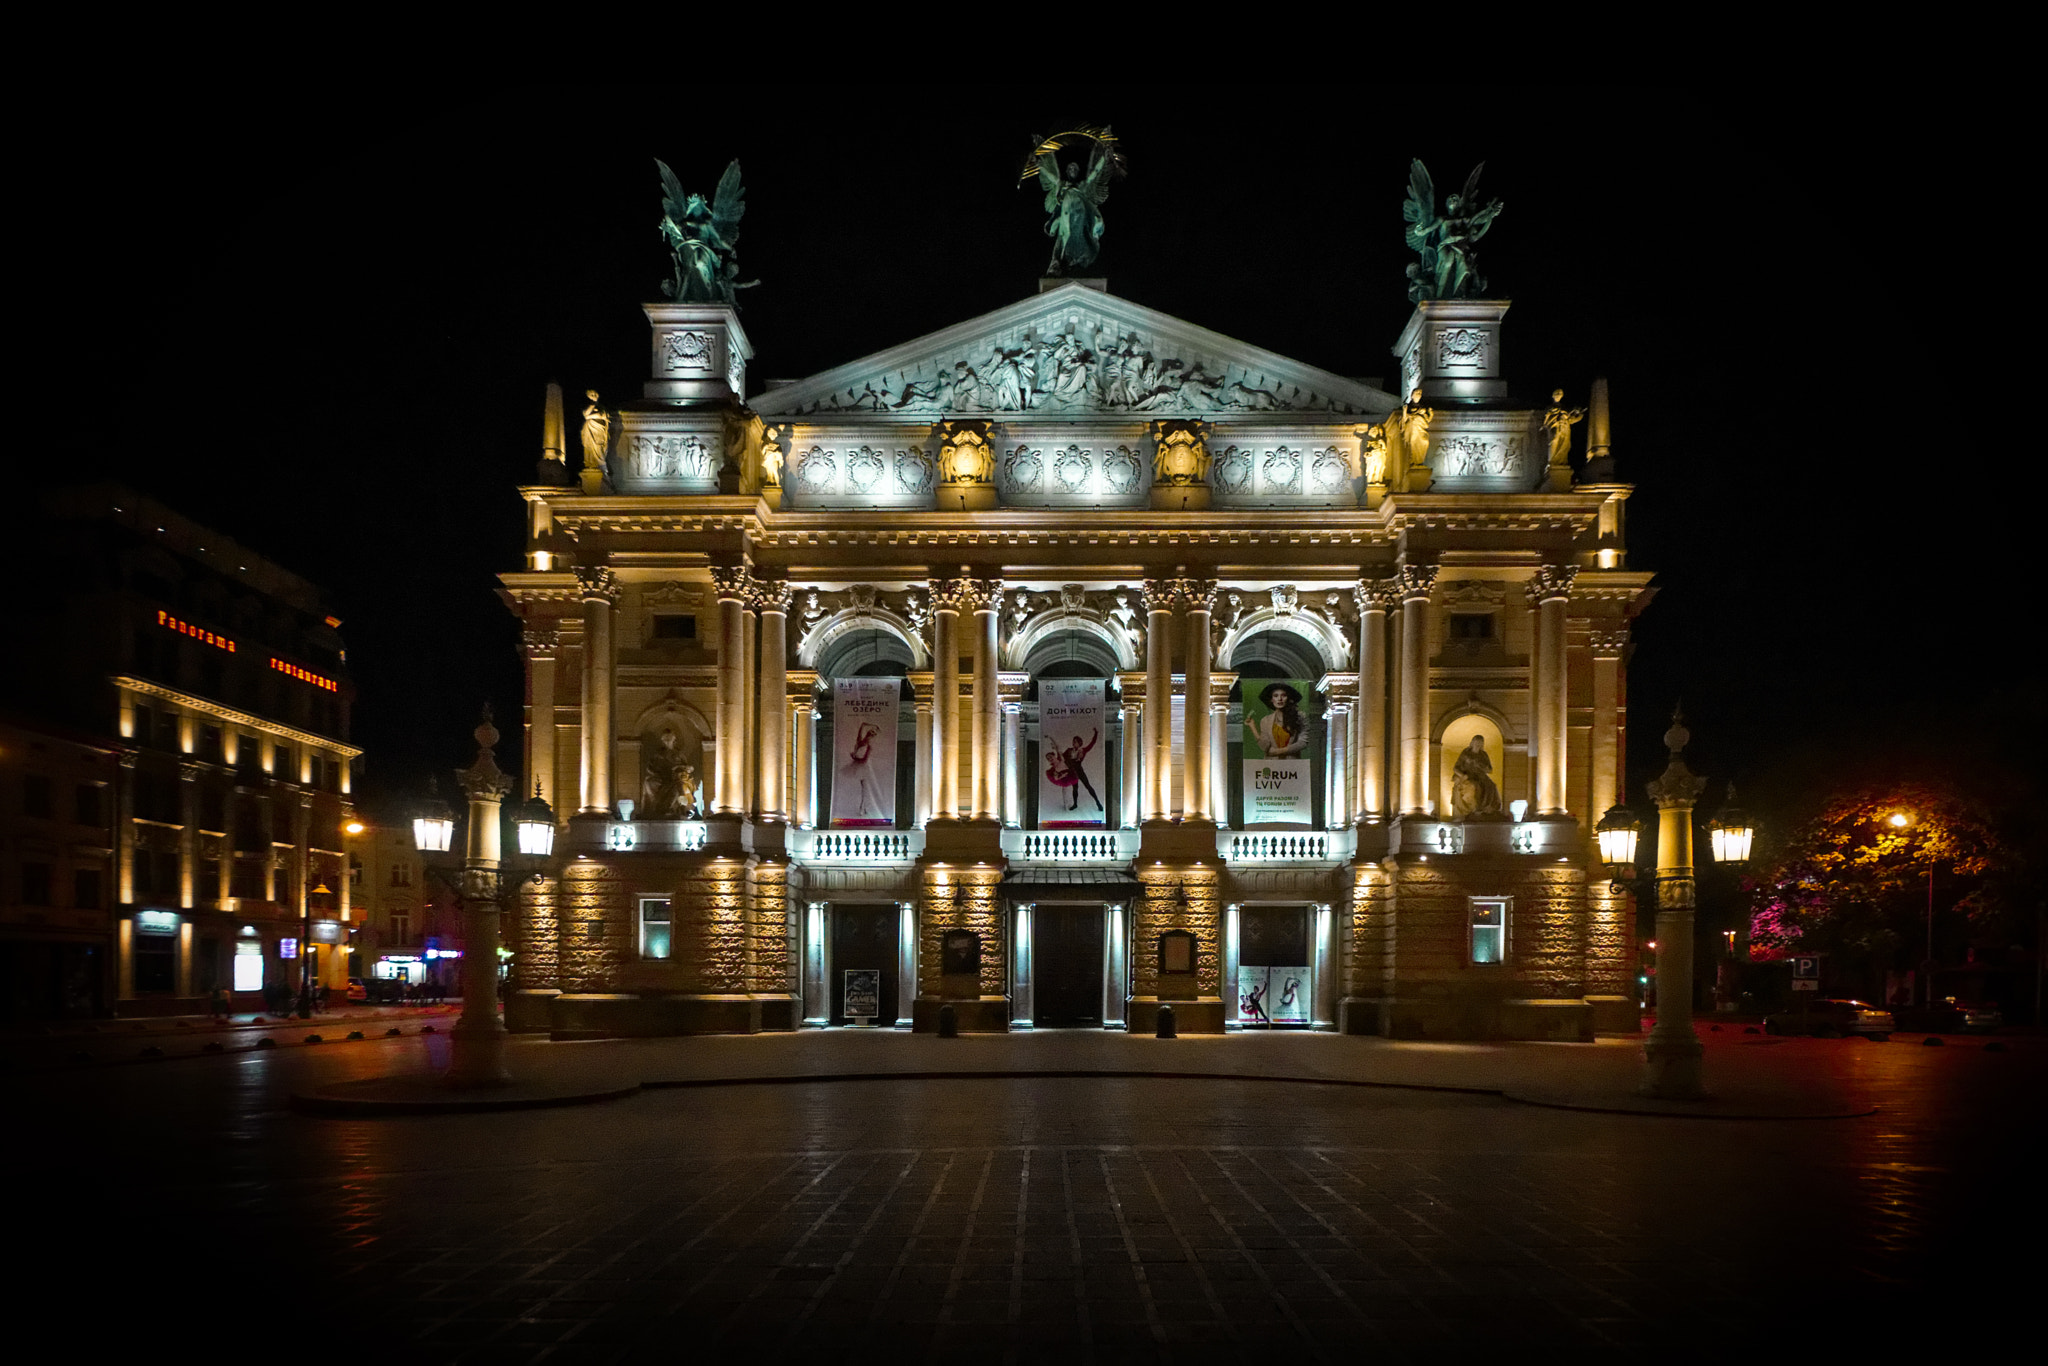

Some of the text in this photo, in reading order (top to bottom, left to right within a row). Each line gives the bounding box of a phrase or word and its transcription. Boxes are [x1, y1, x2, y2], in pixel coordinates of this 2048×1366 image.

[157, 608, 338, 693] Panorama restaurant
[1069, 707, 1097, 715] КІХОТ
[1255, 768, 1298, 780] FORUM
[1256, 781, 1282, 789] LVIV
[1799, 959, 1813, 975] P
